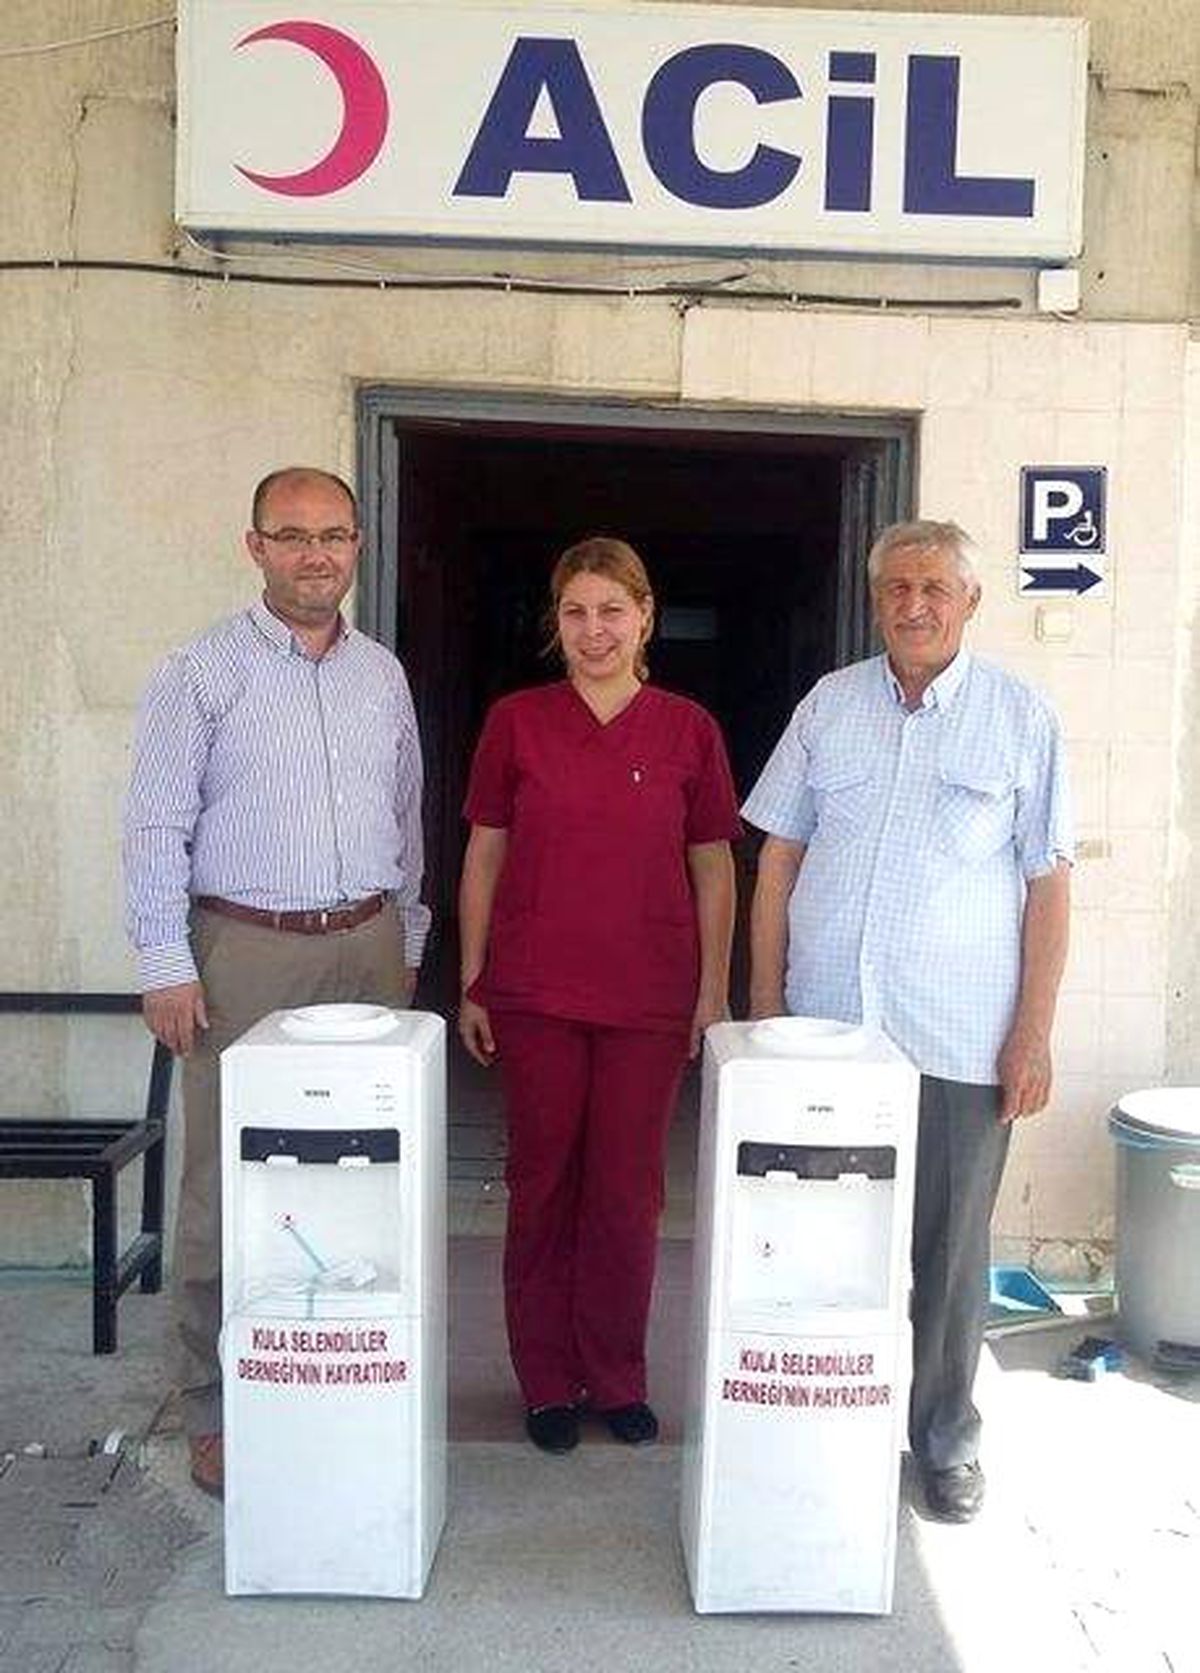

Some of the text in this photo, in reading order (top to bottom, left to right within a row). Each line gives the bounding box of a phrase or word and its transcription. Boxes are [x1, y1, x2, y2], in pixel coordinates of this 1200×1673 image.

[1032, 480, 1083, 541] P
[252, 1328, 287, 1351] KULA
[739, 1349, 777, 1373] KULA
